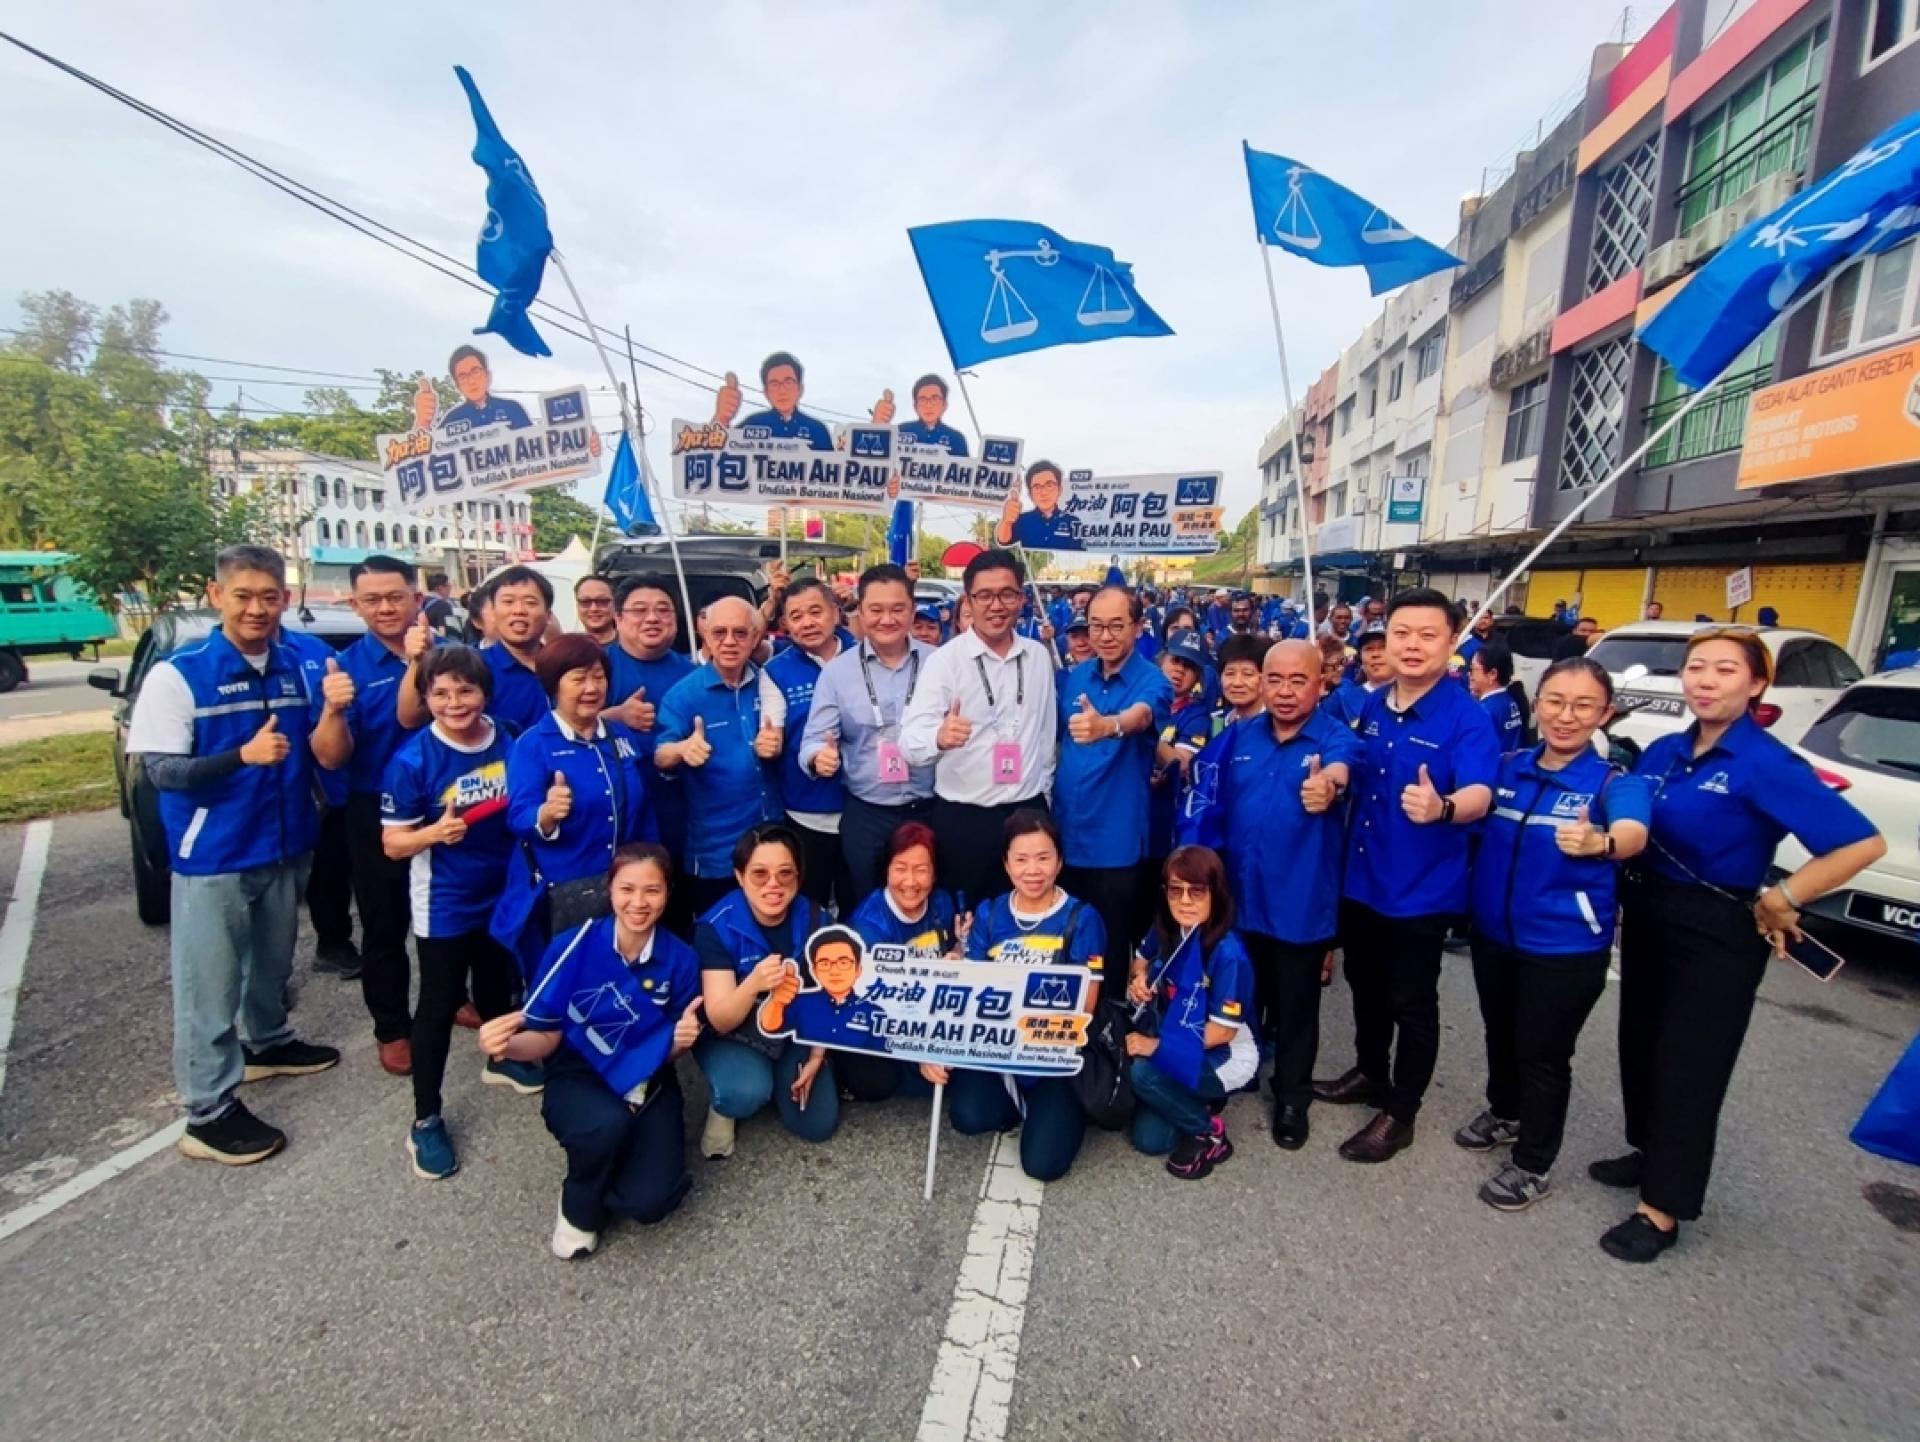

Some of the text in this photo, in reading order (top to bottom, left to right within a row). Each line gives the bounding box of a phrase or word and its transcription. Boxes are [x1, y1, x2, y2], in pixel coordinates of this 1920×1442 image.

[1755, 351, 1914, 411] KEDAI ALAT GANTI KERETA
[384, 429, 432, 471] 加油
[678, 422, 727, 454] 加油
[398, 453, 463, 501] 阿包
[460, 444, 511, 473] TEAM
[515, 436, 543, 462] AH
[546, 427, 587, 455] PAU
[471, 453, 589, 487] Undilah Barisan Nasional
[684, 452, 887, 490] 阿包 TEAM AH PAU
[899, 457, 1013, 489] TEAM AH PAU
[759, 483, 884, 503] Undilah Barisan Nasional
[1065, 491, 1168, 518] 加油 阿包
[1072, 521, 1171, 537] TEAM AH PAU
[875, 949, 903, 961] N29
[860, 977, 1013, 1020] 加油 阿包
[873, 1013, 1017, 1046] TEAM AH PAU
[886, 1039, 1012, 1060] Undilah Barisan Nasional
